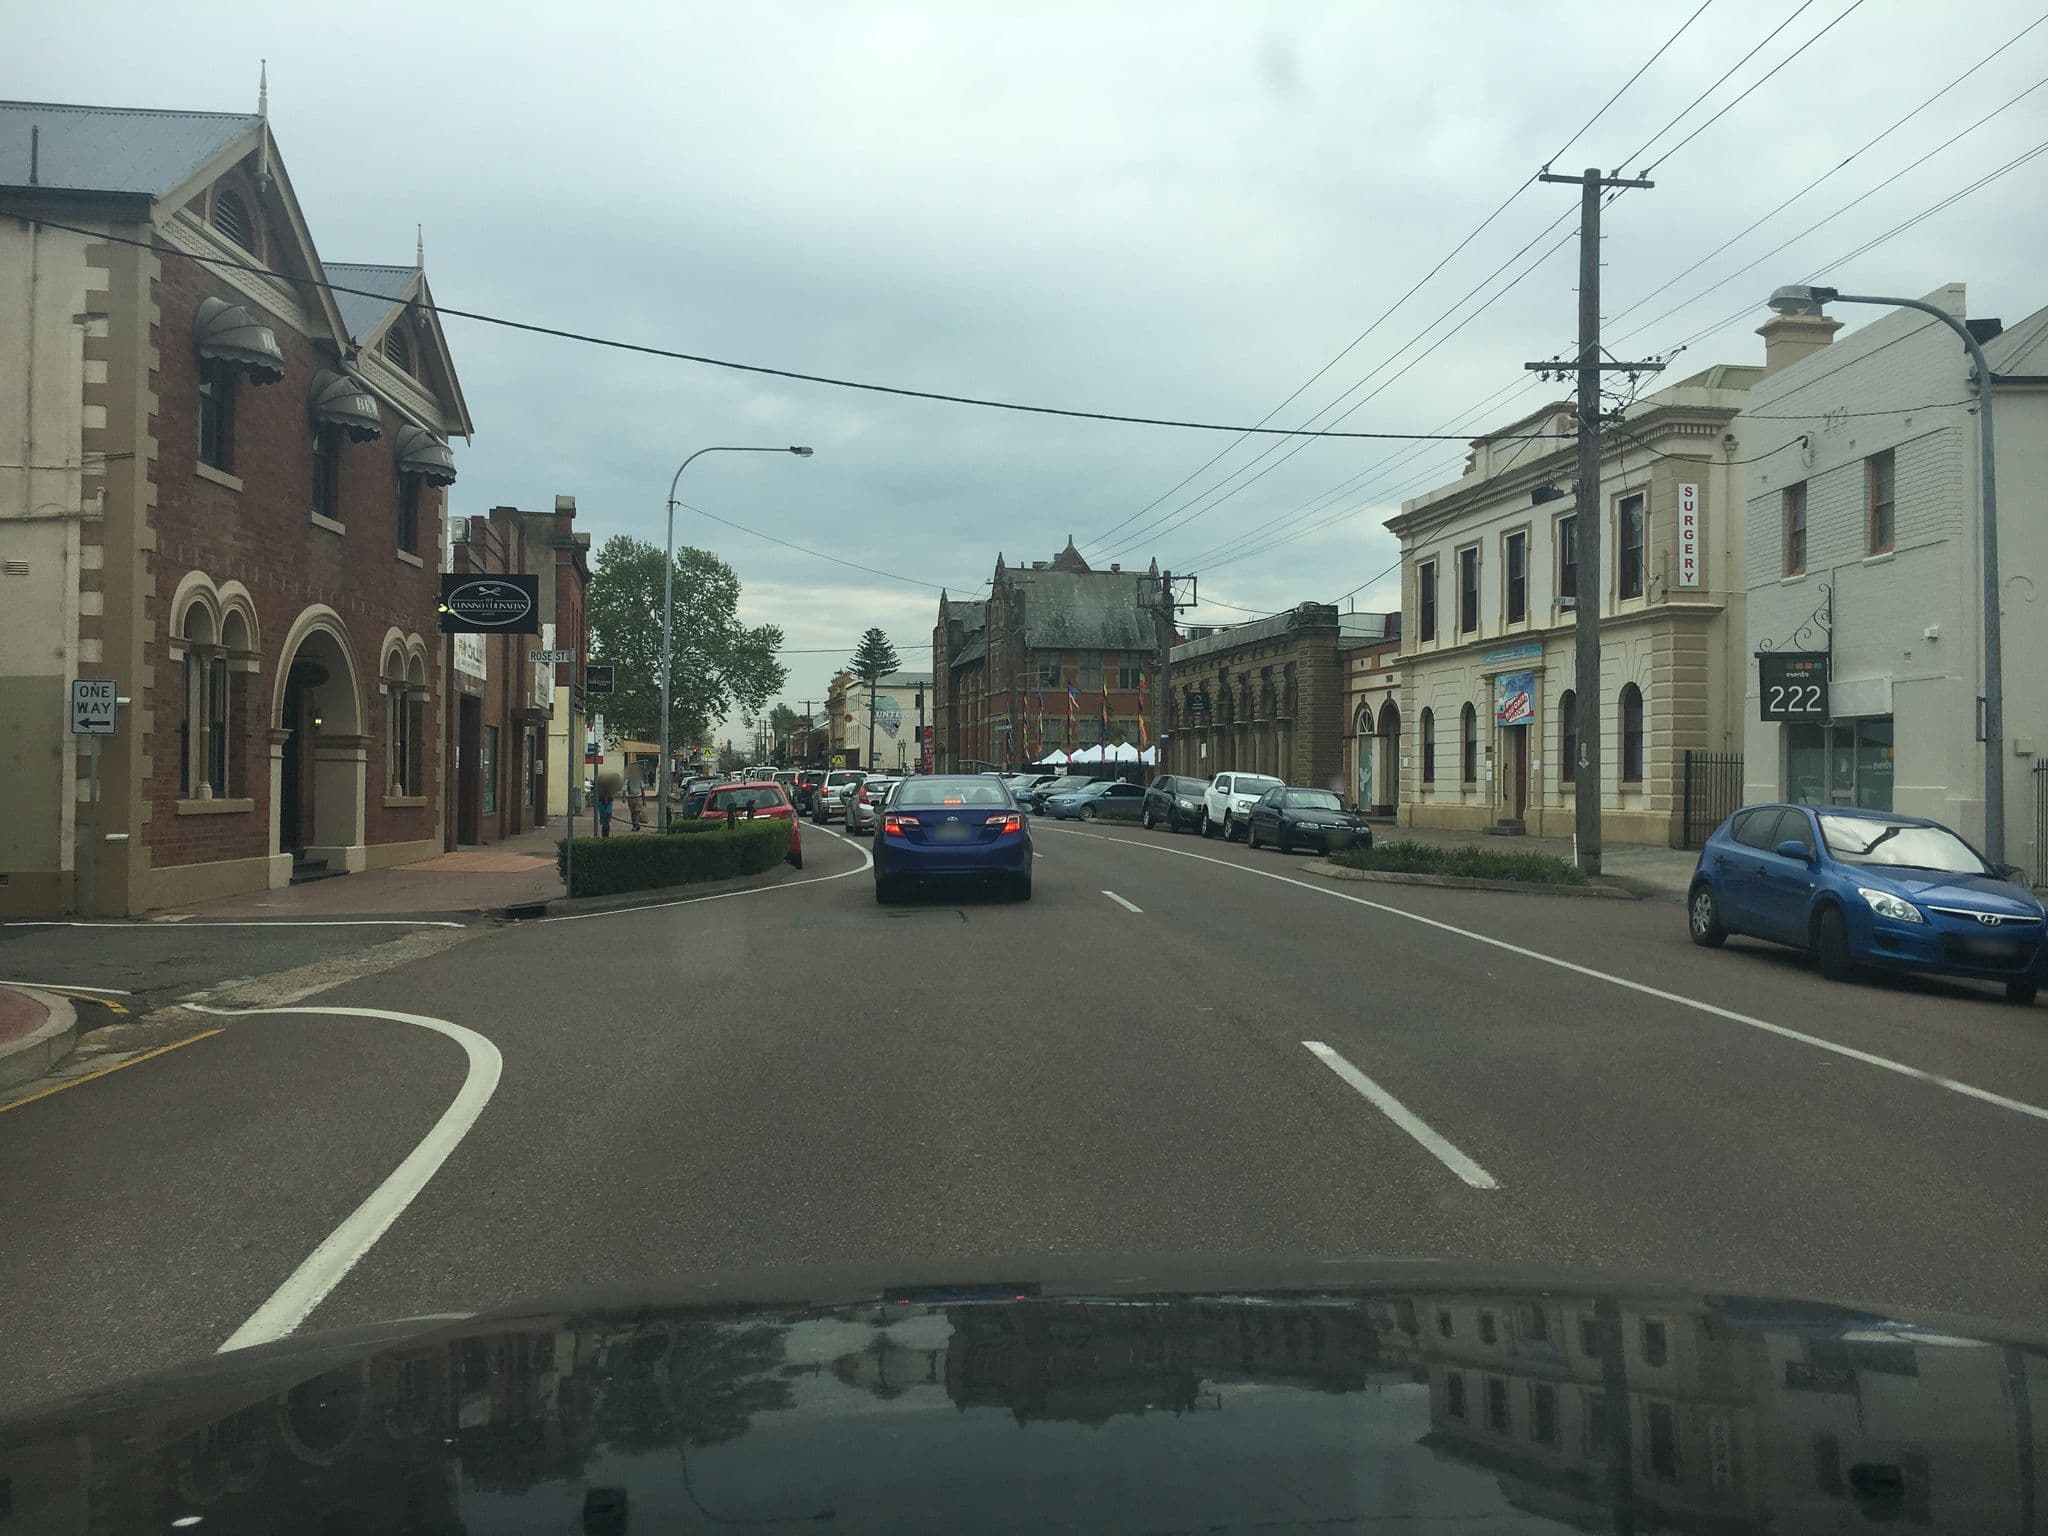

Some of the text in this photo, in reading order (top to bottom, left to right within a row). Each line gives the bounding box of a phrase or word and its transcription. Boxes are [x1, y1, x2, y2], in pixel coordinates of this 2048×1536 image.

[1684, 487, 1694, 582] SURGERY
[530, 651, 565, 661] ROSE ST
[80, 685, 110, 698] ONE
[1770, 686, 1822, 712] 222
[77, 702, 111, 714] WAY
